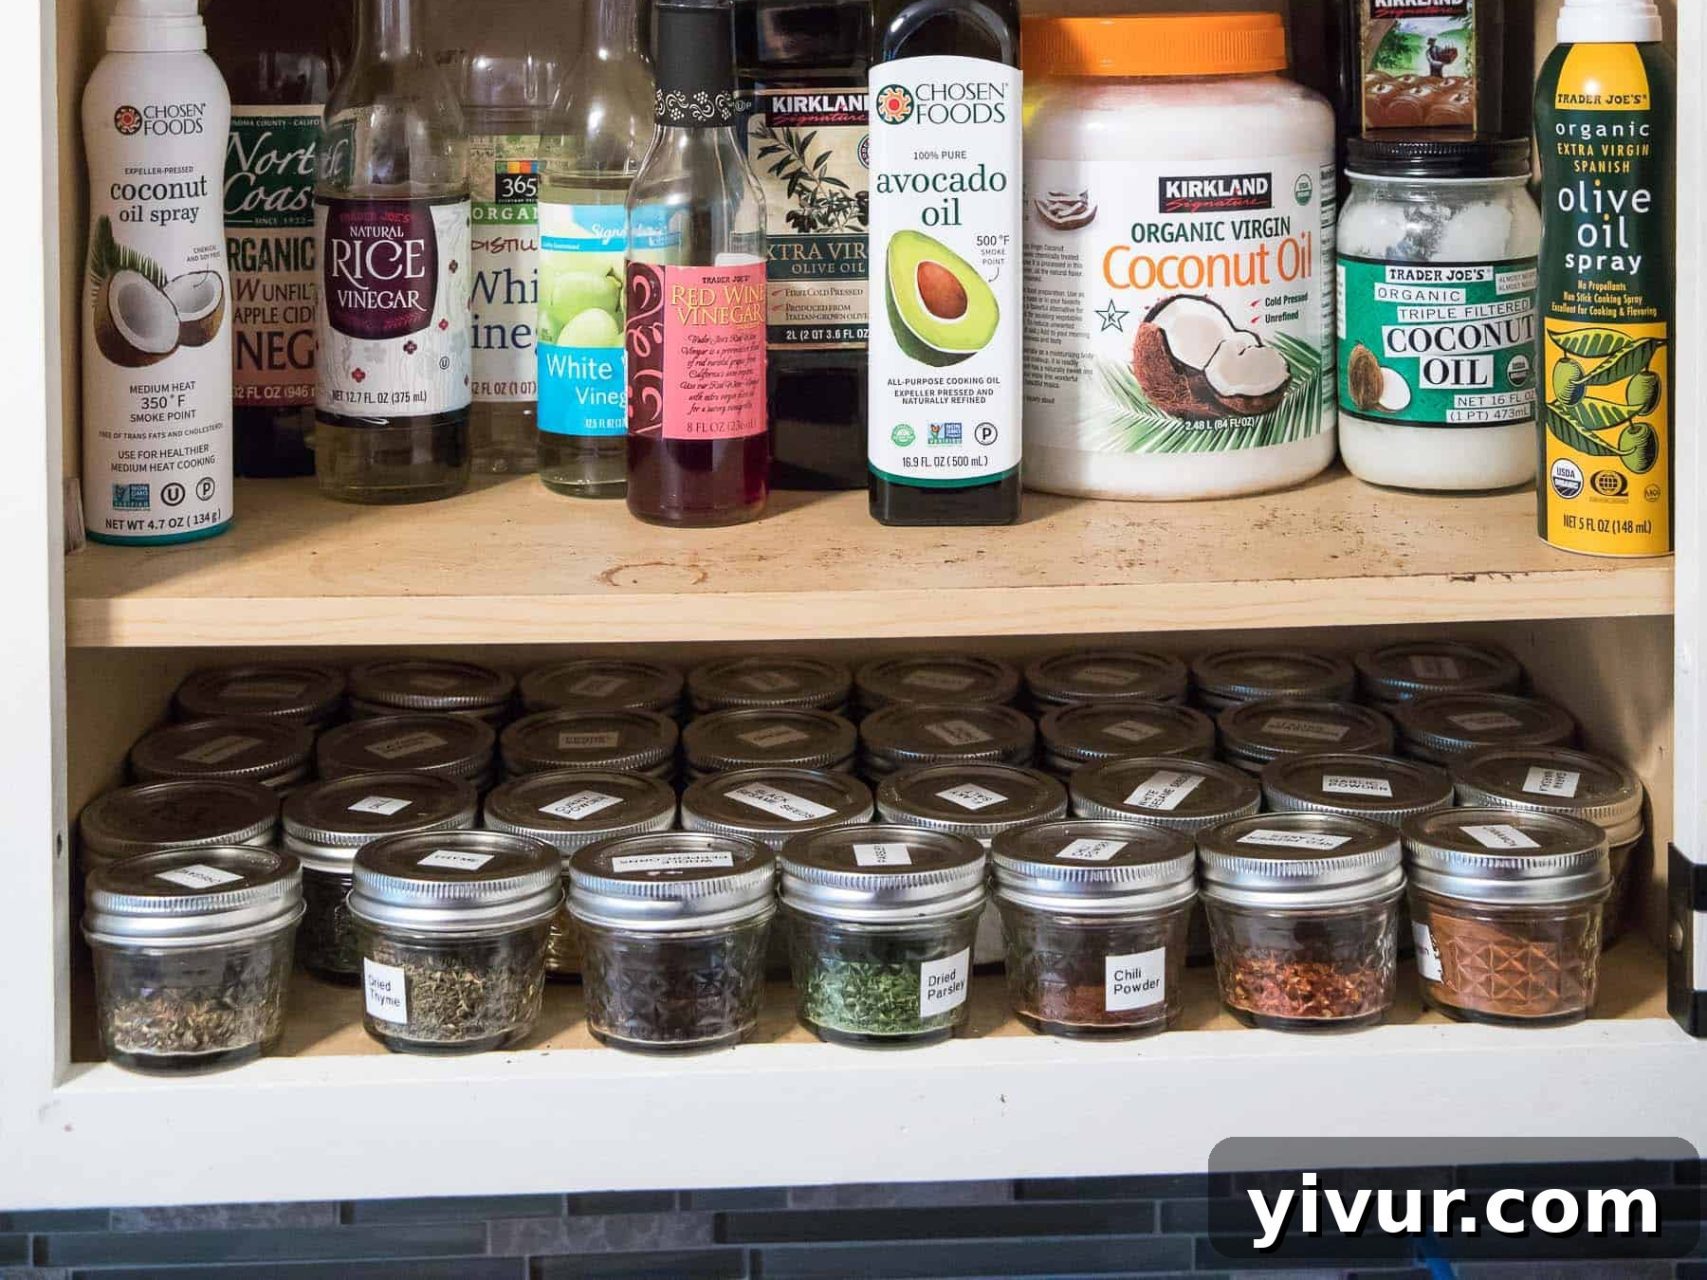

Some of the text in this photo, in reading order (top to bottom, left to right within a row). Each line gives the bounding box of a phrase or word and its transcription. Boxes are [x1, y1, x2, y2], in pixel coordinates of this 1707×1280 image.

[915, 82, 1005, 102] CHOSEN
[1557, 93, 1642, 105] TRADER JOE'S
[143, 103, 204, 120] CHOSEN
[916, 103, 1006, 125] FOODS
[144, 119, 204, 136] FOODS
[1555, 121, 1650, 140] organic
[913, 150, 968, 161] 100% PURE
[1557, 142, 1650, 156] EXTRA VIRGIN
[1573, 160, 1631, 173] SPANISH
[502, 175, 537, 198] 365
[876, 163, 1008, 194] avocado
[110, 175, 208, 201] coconut
[223, 171, 315, 215] Coas
[1166, 177, 1269, 199] KIRKLAND
[1558, 178, 1652, 214] olive
[921, 197, 963, 227] oil
[1166, 197, 1270, 213] Signature
[119, 205, 200, 226] oil spray
[350, 225, 404, 239] NATURAL
[1130, 216, 1291, 244] ORGANIC VIRGIN
[1577, 213, 1629, 249] oil
[976, 235, 997, 247] 500
[980, 248, 1007, 256] SMOKE
[331, 238, 426, 290] RICE
[791, 262, 866, 275] OLIVE OIL
[1102, 231, 1313, 291] Coconut Oil
[1564, 252, 1642, 276] spray
[702, 276, 731, 284] TRADER
[1388, 268, 1485, 281] TRADER JOE'S
[1378, 287, 1461, 302] ORGANIC
[1577, 280, 1627, 293] No Propellants
[337, 290, 427, 312] VINEGAR
[671, 284, 716, 306] RED
[1264, 295, 1282, 308] Cold
[1563, 291, 1643, 306] Non Stick Cooking Spray
[233, 307, 278, 324] APPLE
[677, 303, 765, 327] VINEGAR
[1264, 310, 1299, 324] Unrefined
[1399, 299, 1529, 320] TRIPLE FILTERED
[1577, 303, 1618, 318] for Cooking
[786, 329, 855, 340] 2L FL
[1386, 313, 1535, 353] COCONUT
[546, 353, 613, 380] White
[1423, 357, 1488, 386] OIL
[129, 381, 196, 394] MEDIUM HEAT
[482, 382, 507, 394] FL OZ
[887, 376, 1001, 386] ALL-PURPOSE COOKING OIL
[264, 387, 281, 399] OZ
[345, 391, 411, 405] 12.7 OZ (375
[894, 388, 994, 397] EXPELLER PRESSED AND
[902, 396, 986, 405] NATURALLY REFINED
[1457, 393, 1521, 407] NET 16 FL
[130, 410, 196, 423] SMOKE POINT
[1466, 411, 1489, 421] PT)
[118, 444, 209, 460] USE FOR HEALTHIER
[111, 455, 216, 472] MEDIUM HEAT COOKING
[902, 456, 945, 468] 16.9 OZ
[1556, 466, 1576, 479] USDA
[105, 516, 185, 531] NET WT 4.7 OZ
[1563, 514, 1653, 535] NET 5 FL OZ (148 mL)
[928, 967, 957, 987] Dried
[1113, 968, 1143, 983] Chili
[927, 977, 966, 1001] Parsley
[1113, 978, 1161, 996] Powder
[369, 987, 401, 1008] Thyme
